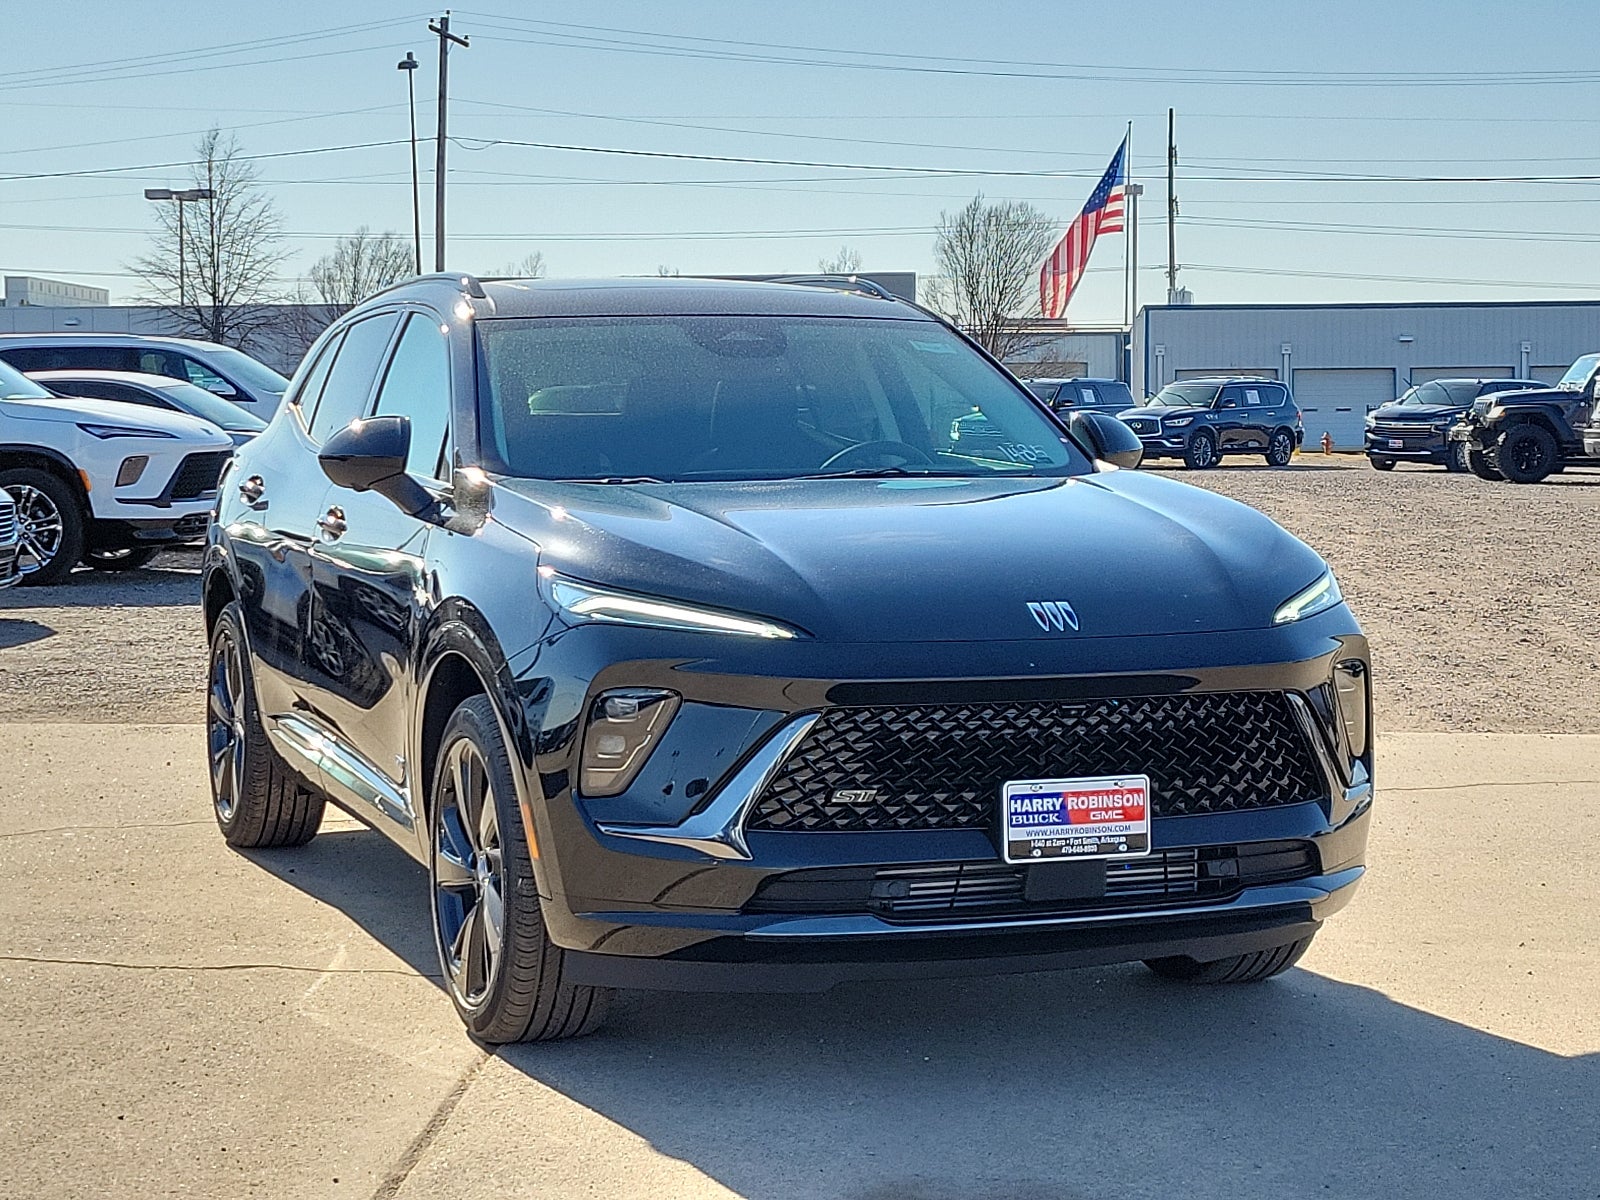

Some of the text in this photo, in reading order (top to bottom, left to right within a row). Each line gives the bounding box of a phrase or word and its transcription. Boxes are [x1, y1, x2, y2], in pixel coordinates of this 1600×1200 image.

[1010, 793, 1144, 813] HARRY ROBINSON
[1011, 809, 1124, 825] BUICK GMC
[1026, 825, 1131, 837] WWW.HARRYROBINSON.COM
